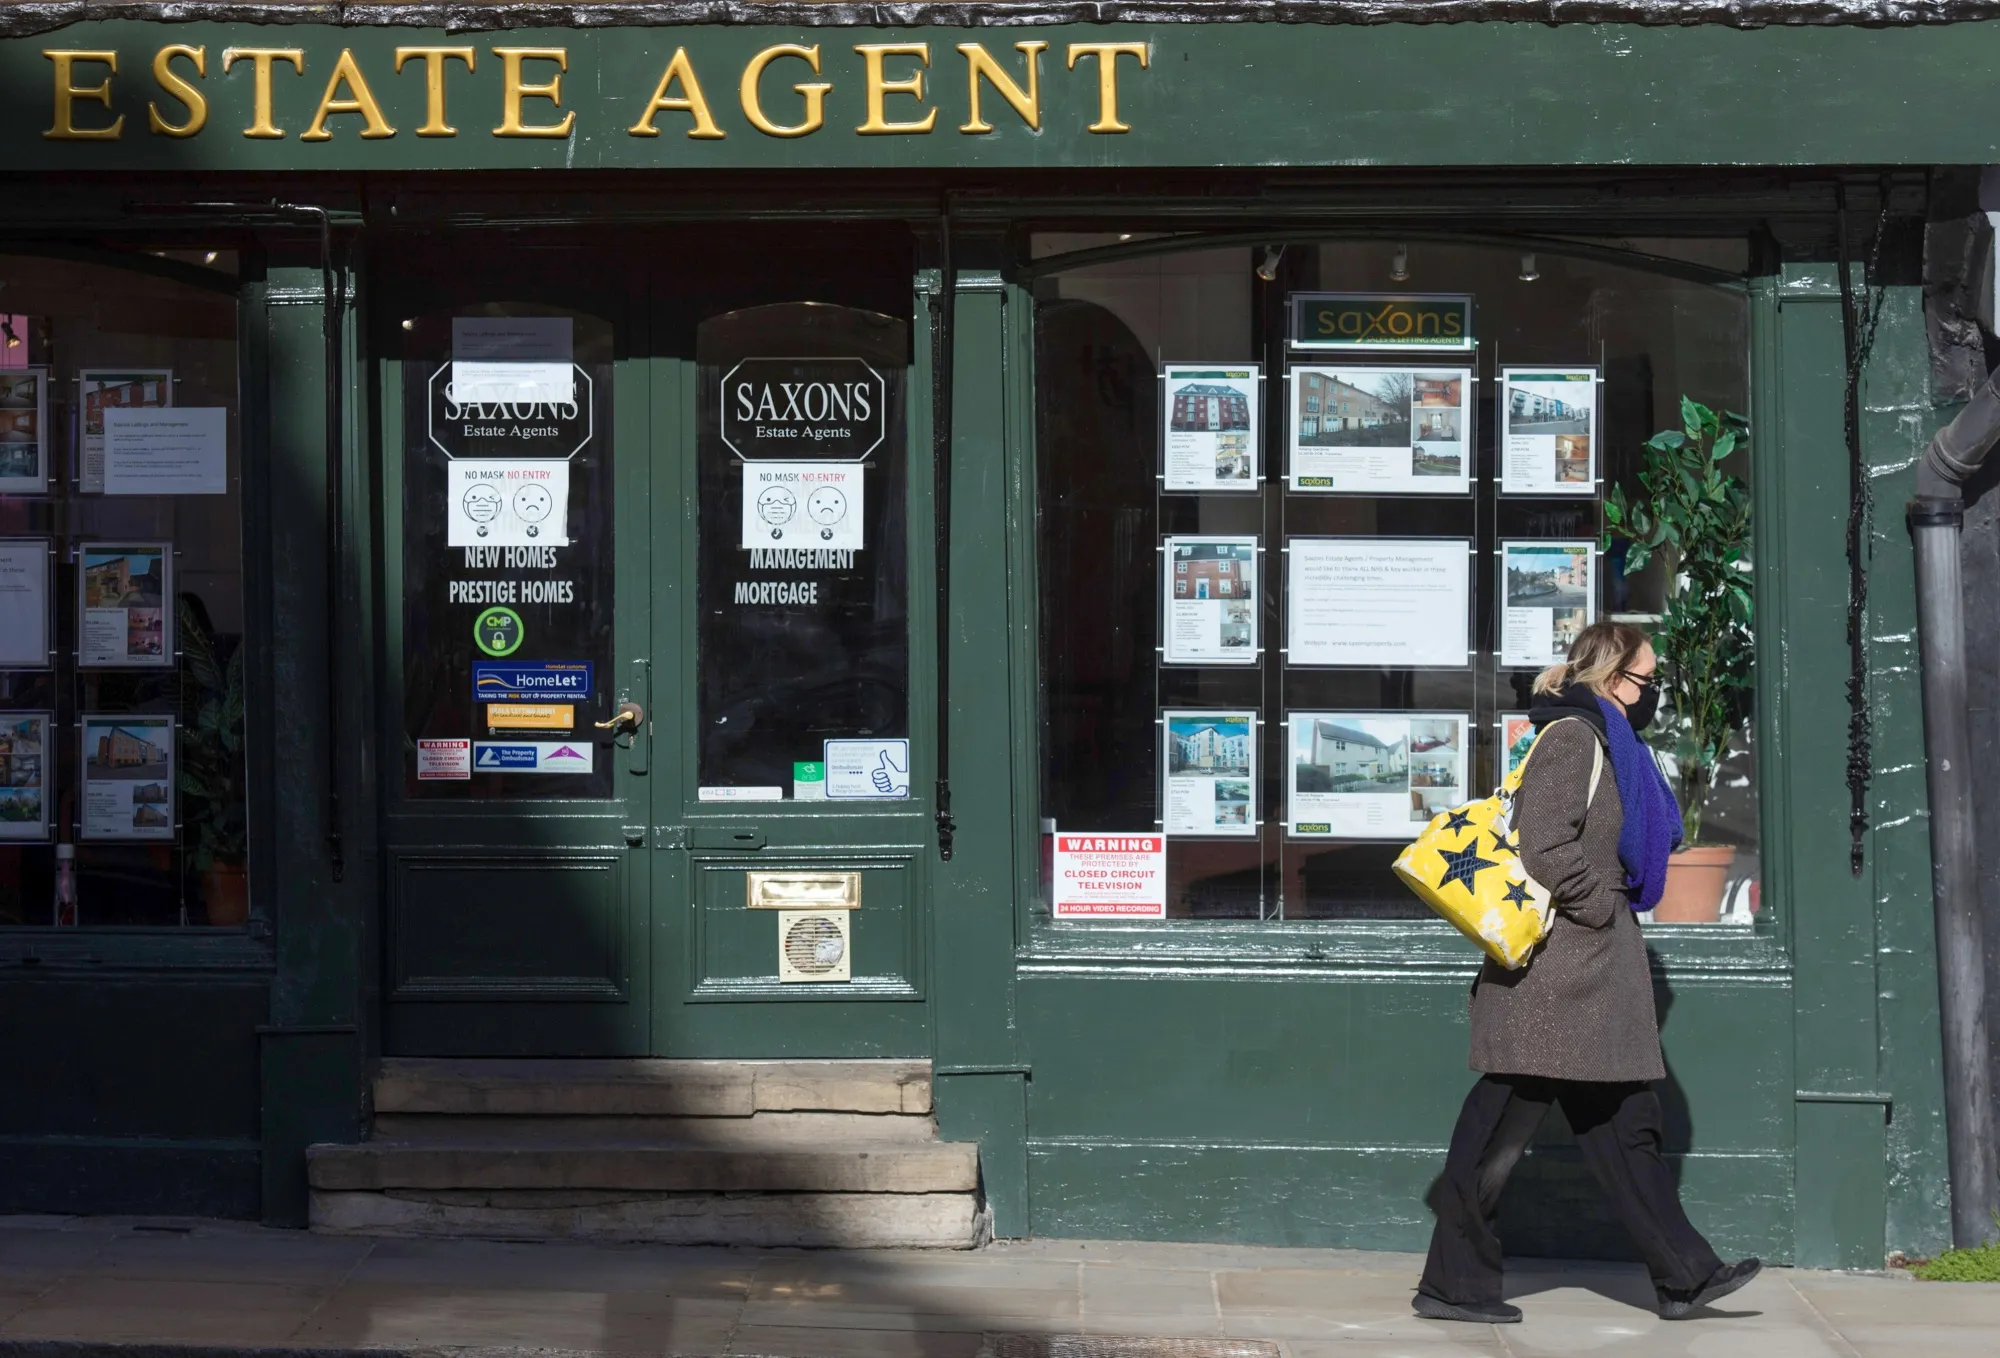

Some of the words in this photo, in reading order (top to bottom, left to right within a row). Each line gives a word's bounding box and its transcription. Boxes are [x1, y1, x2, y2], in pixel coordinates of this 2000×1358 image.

[42, 44, 576, 142] ESTATE
[628, 41, 1149, 140] AGENT
[1318, 304, 1462, 344] saxons
[1397, 336, 1429, 344] LETTING
[1430, 336, 1461, 344] AGENTS
[737, 382, 871, 421] SAXONS
[464, 425, 506, 437] Estate
[509, 425, 559, 439] Agents
[756, 426, 798, 438] Estate
[802, 426, 851, 440] Agents
[465, 470, 479, 480] NO
[480, 470, 504, 480] MASK
[507, 470, 520, 480] NO
[523, 470, 551, 480] ENTRY
[760, 473, 772, 482] NO
[775, 473, 799, 482] MASK
[802, 473, 815, 482] NO
[817, 473, 846, 482] ENTRY
[1300, 477, 1331, 487] saxons
[465, 547, 500, 569] NEW
[505, 547, 557, 569] HOMES
[750, 549, 854, 569] MANAGEMENT
[449, 580, 516, 604] PRESTIGE
[521, 580, 574, 604] HOMES
[734, 582, 818, 604] MORTGAGE
[486, 616, 512, 627] CMP
[516, 674, 577, 687] HomeLet
[1511, 723, 1527, 739] LET
[512, 749, 535, 758] Property
[1298, 823, 1329, 833] saxons
[1066, 839, 1154, 851] WARNING
[1064, 870, 1108, 878] CLOSED
[1110, 870, 1156, 878] CIRCUIT
[1077, 882, 1143, 890] TELEVISION
